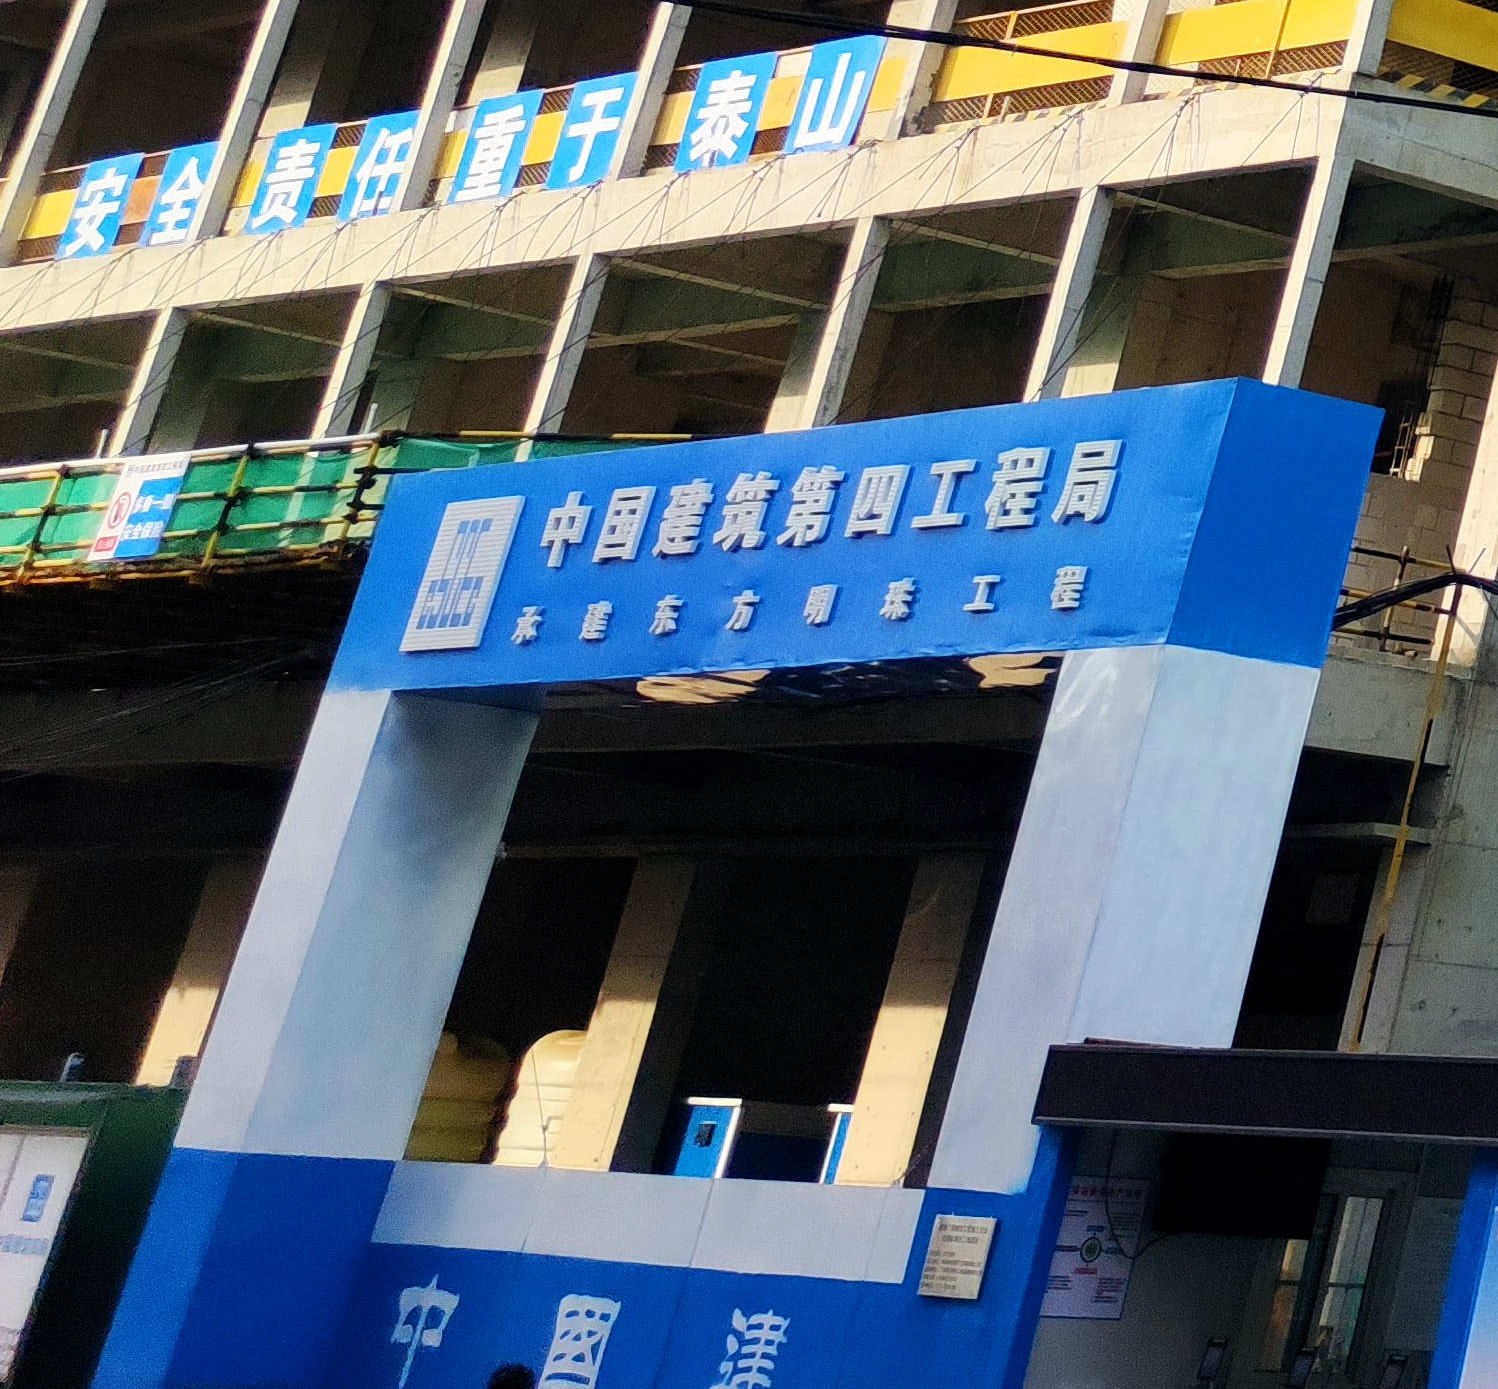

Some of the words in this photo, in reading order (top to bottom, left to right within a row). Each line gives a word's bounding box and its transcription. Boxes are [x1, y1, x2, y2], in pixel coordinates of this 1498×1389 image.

[63, 54, 869, 258] 安全责任重于泰山
[541, 439, 1123, 567] 中国建筑第四工程局
[511, 565, 1089, 644] 承建东方明珠工程
